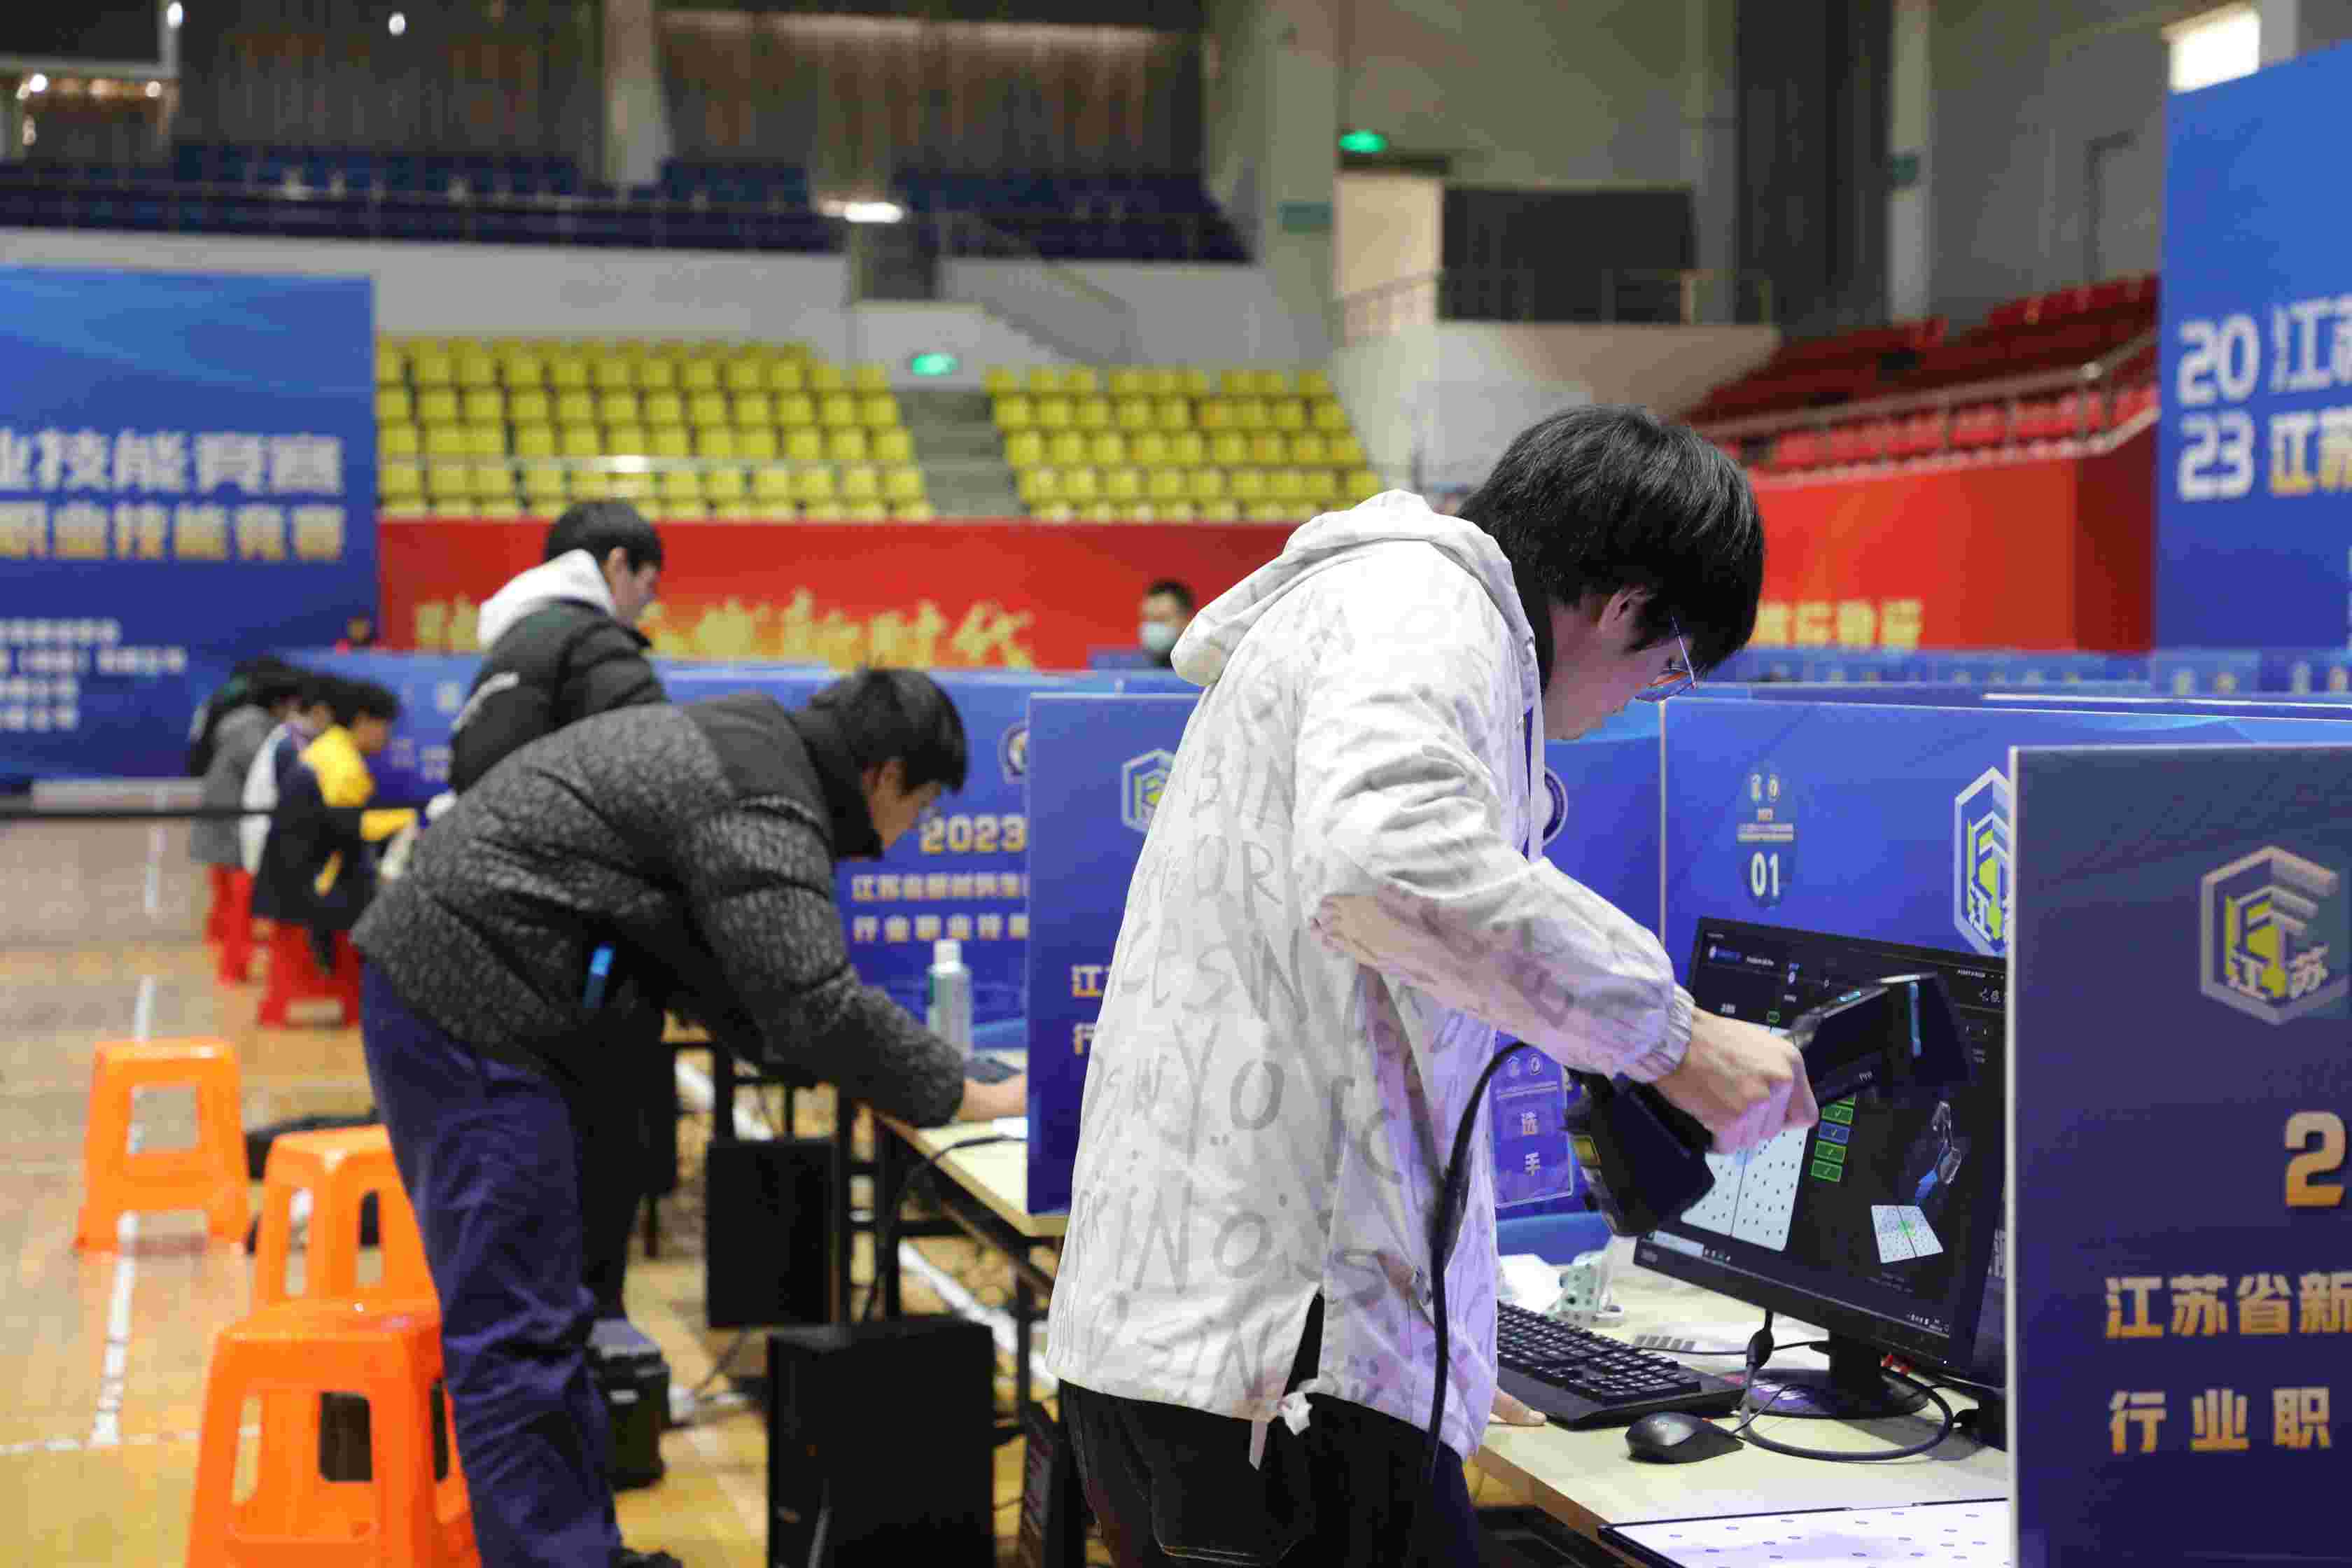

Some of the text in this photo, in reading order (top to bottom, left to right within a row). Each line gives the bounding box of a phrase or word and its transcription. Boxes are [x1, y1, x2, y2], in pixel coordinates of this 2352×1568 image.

[2177, 293, 2352, 406] 20 江
[2177, 410, 2255, 503] 23
[920, 814, 1027, 855] 2023
[1750, 851, 1779, 897] 01
[2284, 1112, 2346, 1208] 2
[2105, 1270, 2352, 1339] 江苏省新
[2108, 1387, 2332, 1455] 行业职
